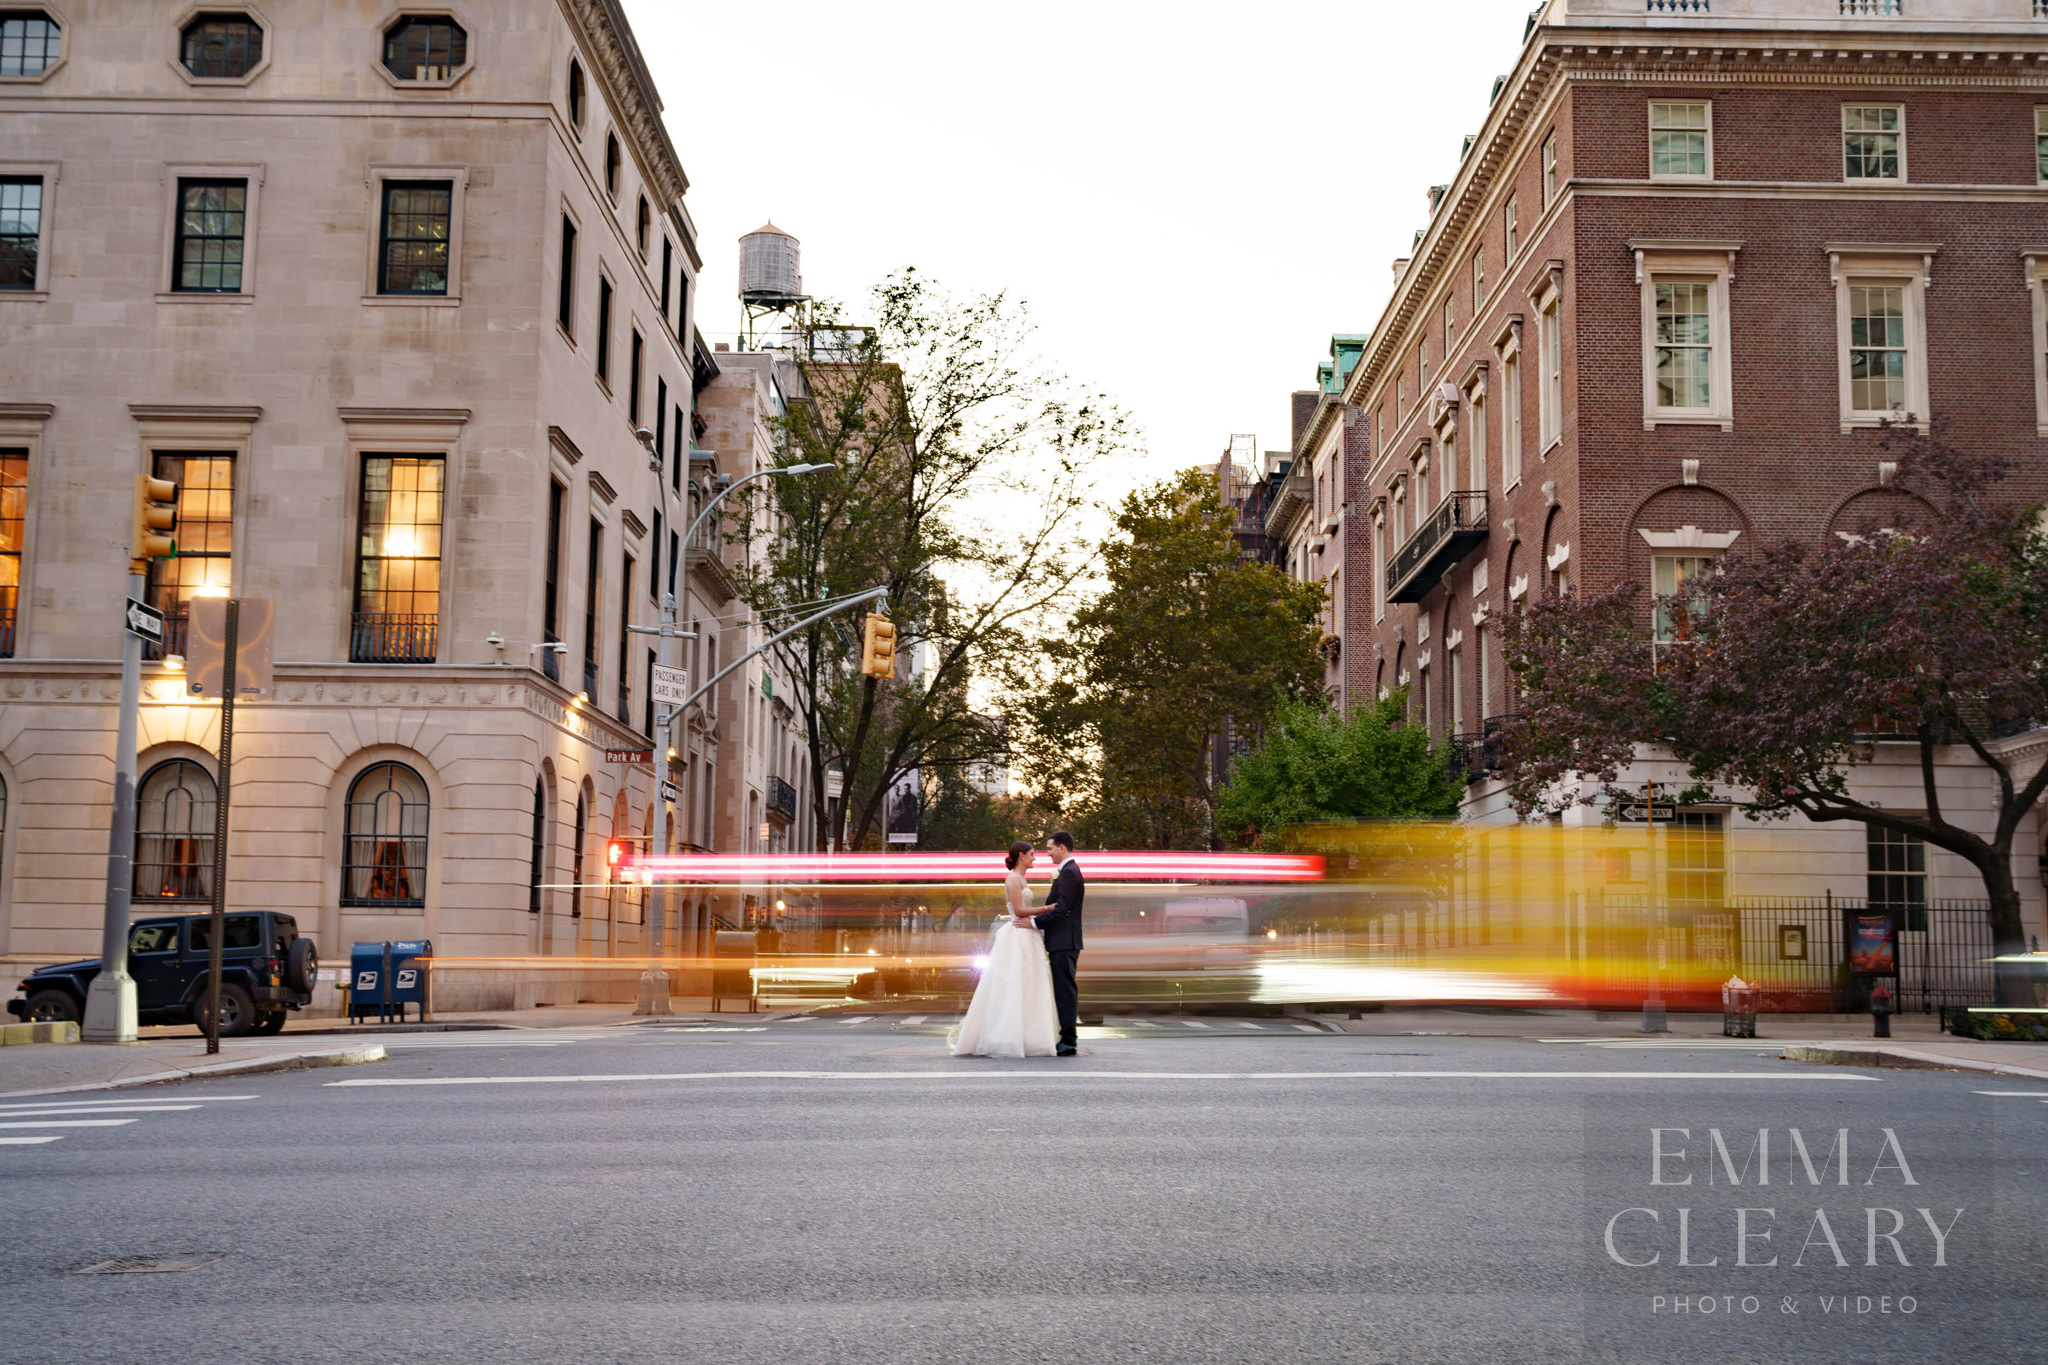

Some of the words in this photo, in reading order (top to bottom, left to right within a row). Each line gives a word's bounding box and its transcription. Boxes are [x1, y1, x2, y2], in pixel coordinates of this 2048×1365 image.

[146, 616, 159, 631] WAY
[655, 669, 686, 685] PASSENGER
[655, 683, 668, 697] CARS
[672, 686, 685, 700] ONLY
[607, 752, 627, 762] Park
[630, 752, 641, 762] Av
[1627, 808, 1643, 817] ONE
[1652, 809, 1669, 817] WAY
